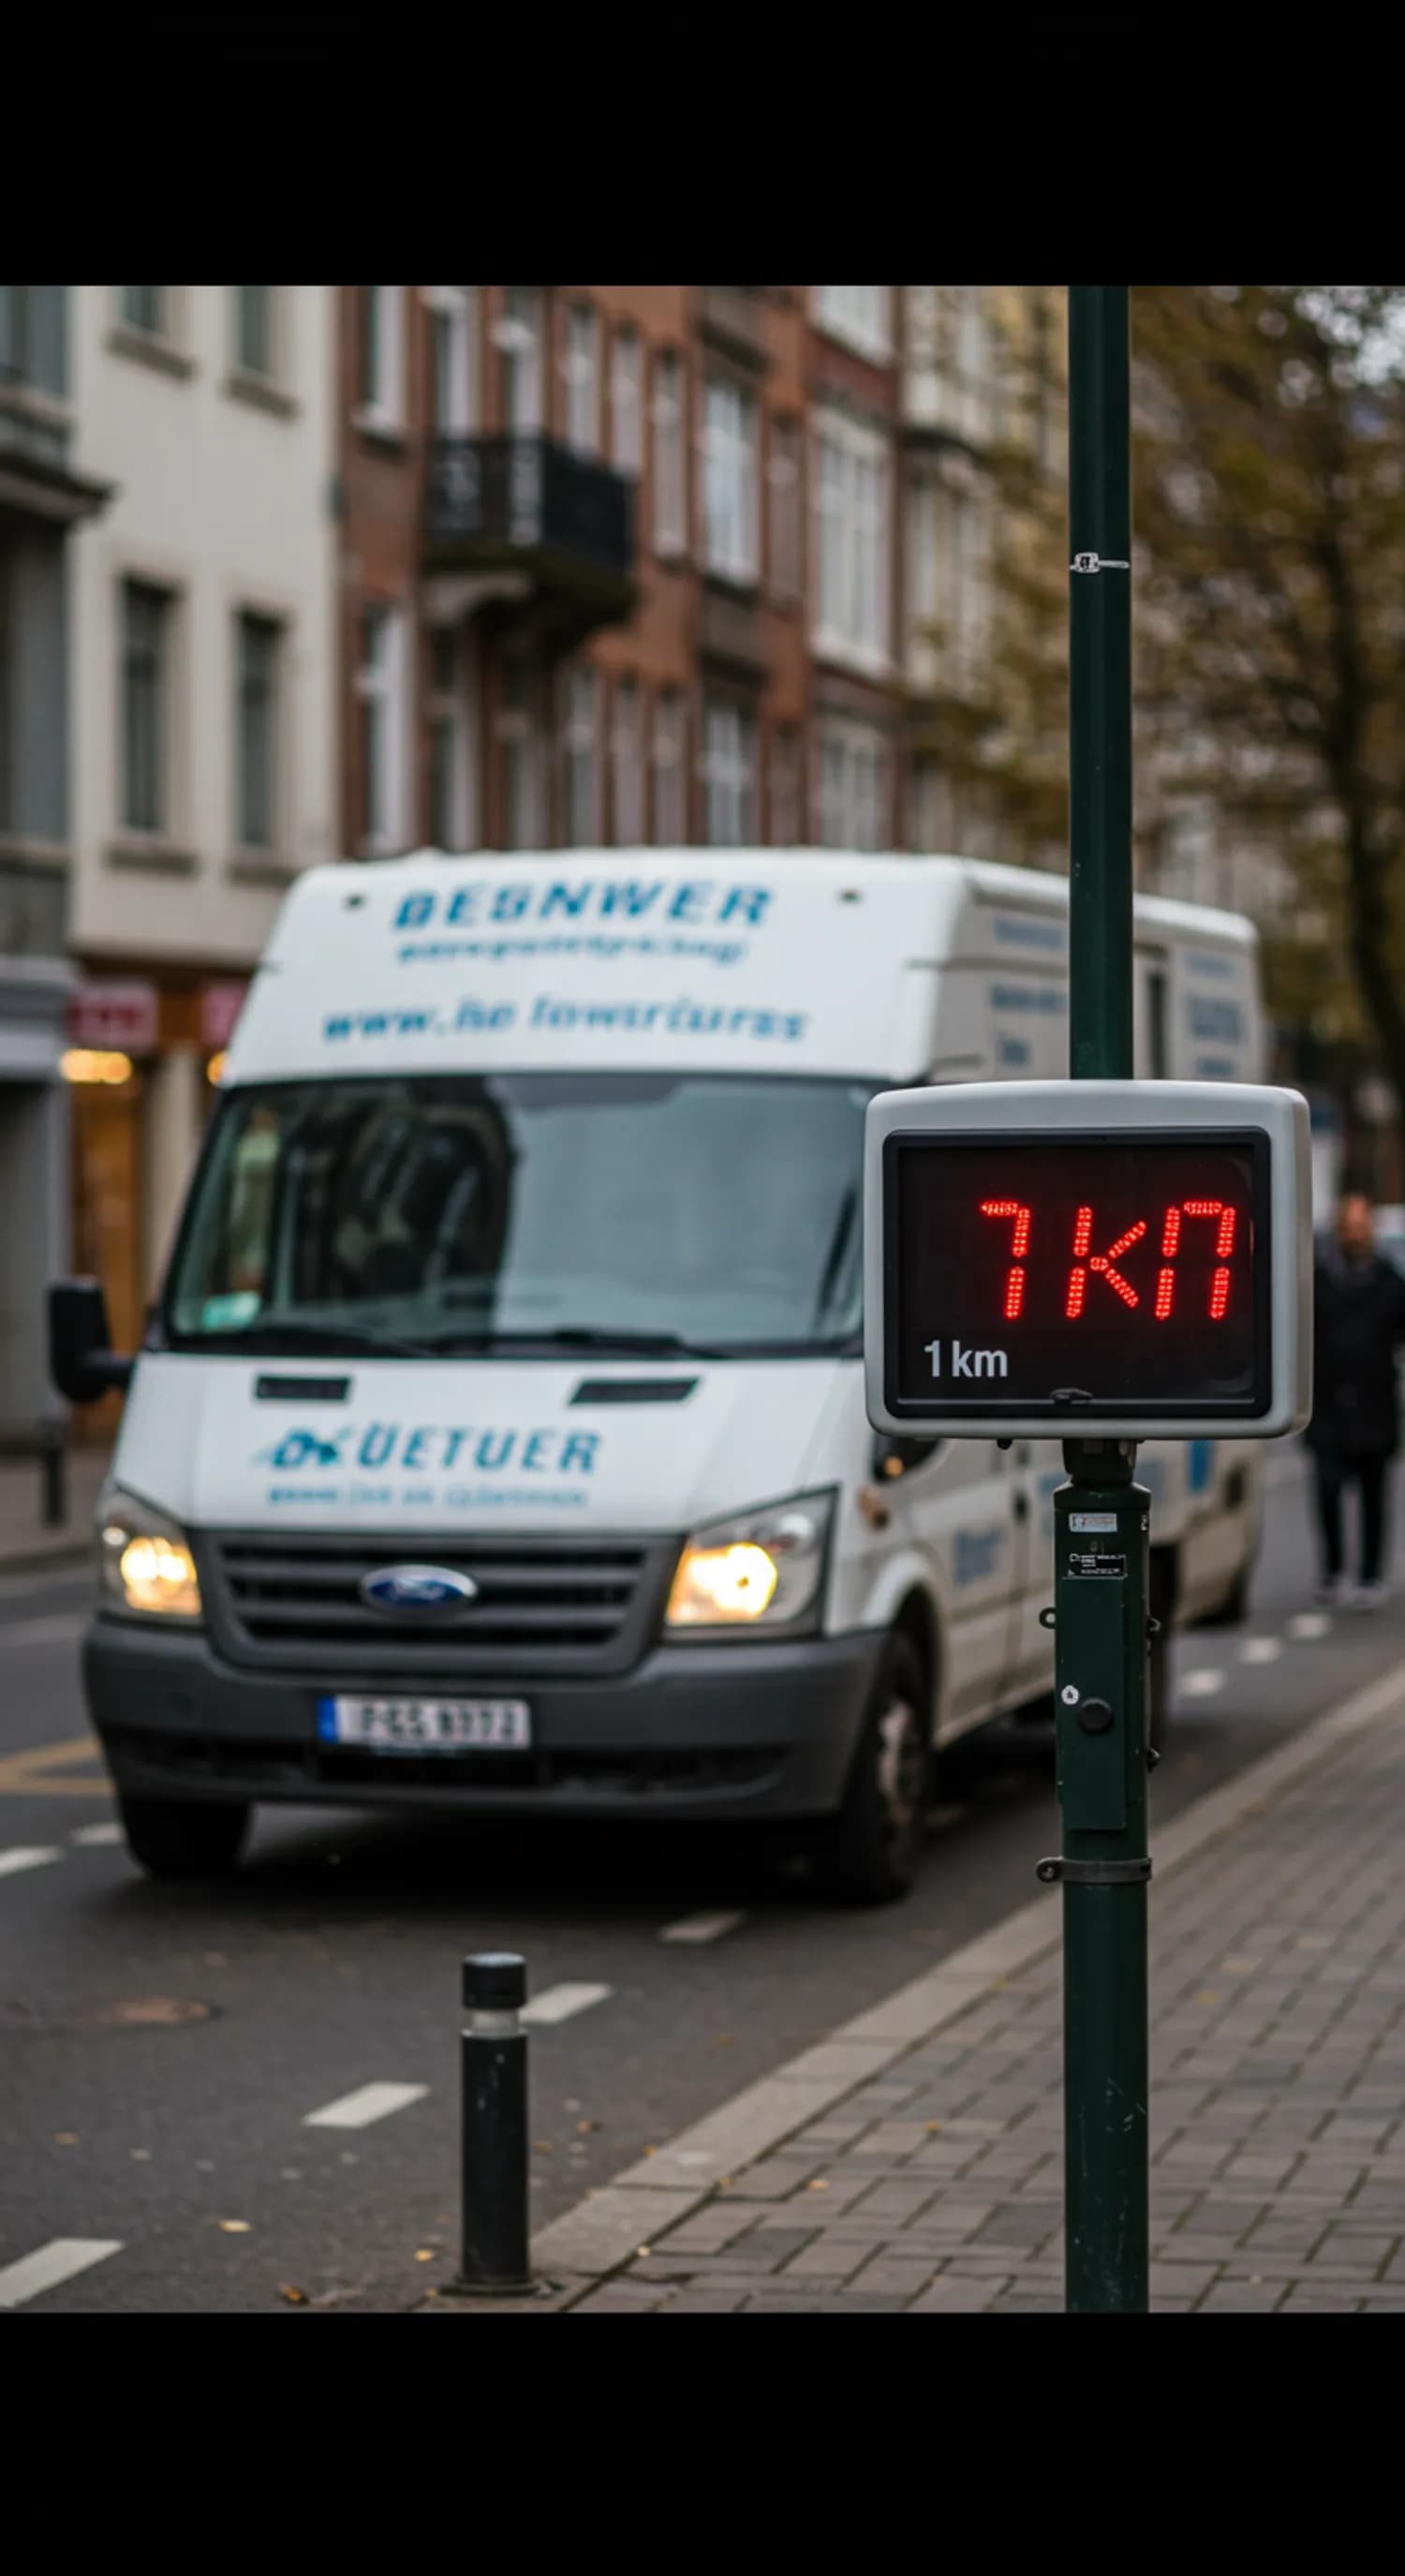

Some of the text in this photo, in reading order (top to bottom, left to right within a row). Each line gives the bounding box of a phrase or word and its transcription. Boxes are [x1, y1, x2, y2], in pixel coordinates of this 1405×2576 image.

[978, 1199, 1031, 1321] 7
[924, 1340, 1009, 1378] 1 km
